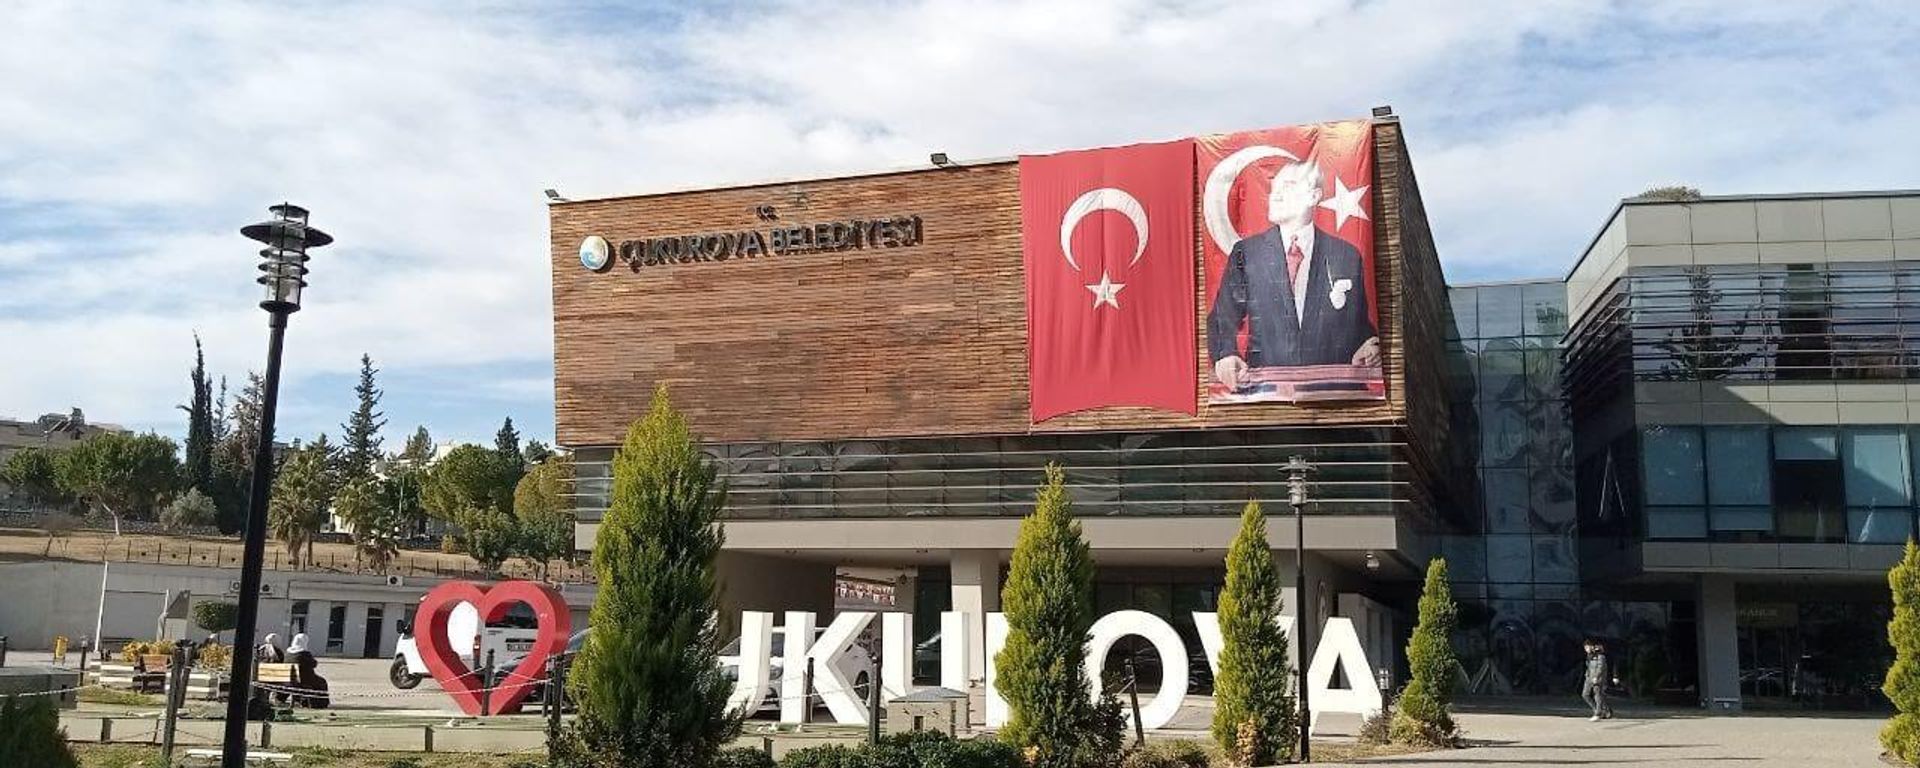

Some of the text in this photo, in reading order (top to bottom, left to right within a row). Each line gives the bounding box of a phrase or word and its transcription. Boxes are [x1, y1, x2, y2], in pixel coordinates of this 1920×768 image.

[620, 215, 923, 272] ÇUKUROVA BELEDİYESİ
[724, 609, 1383, 737] UKUOA
